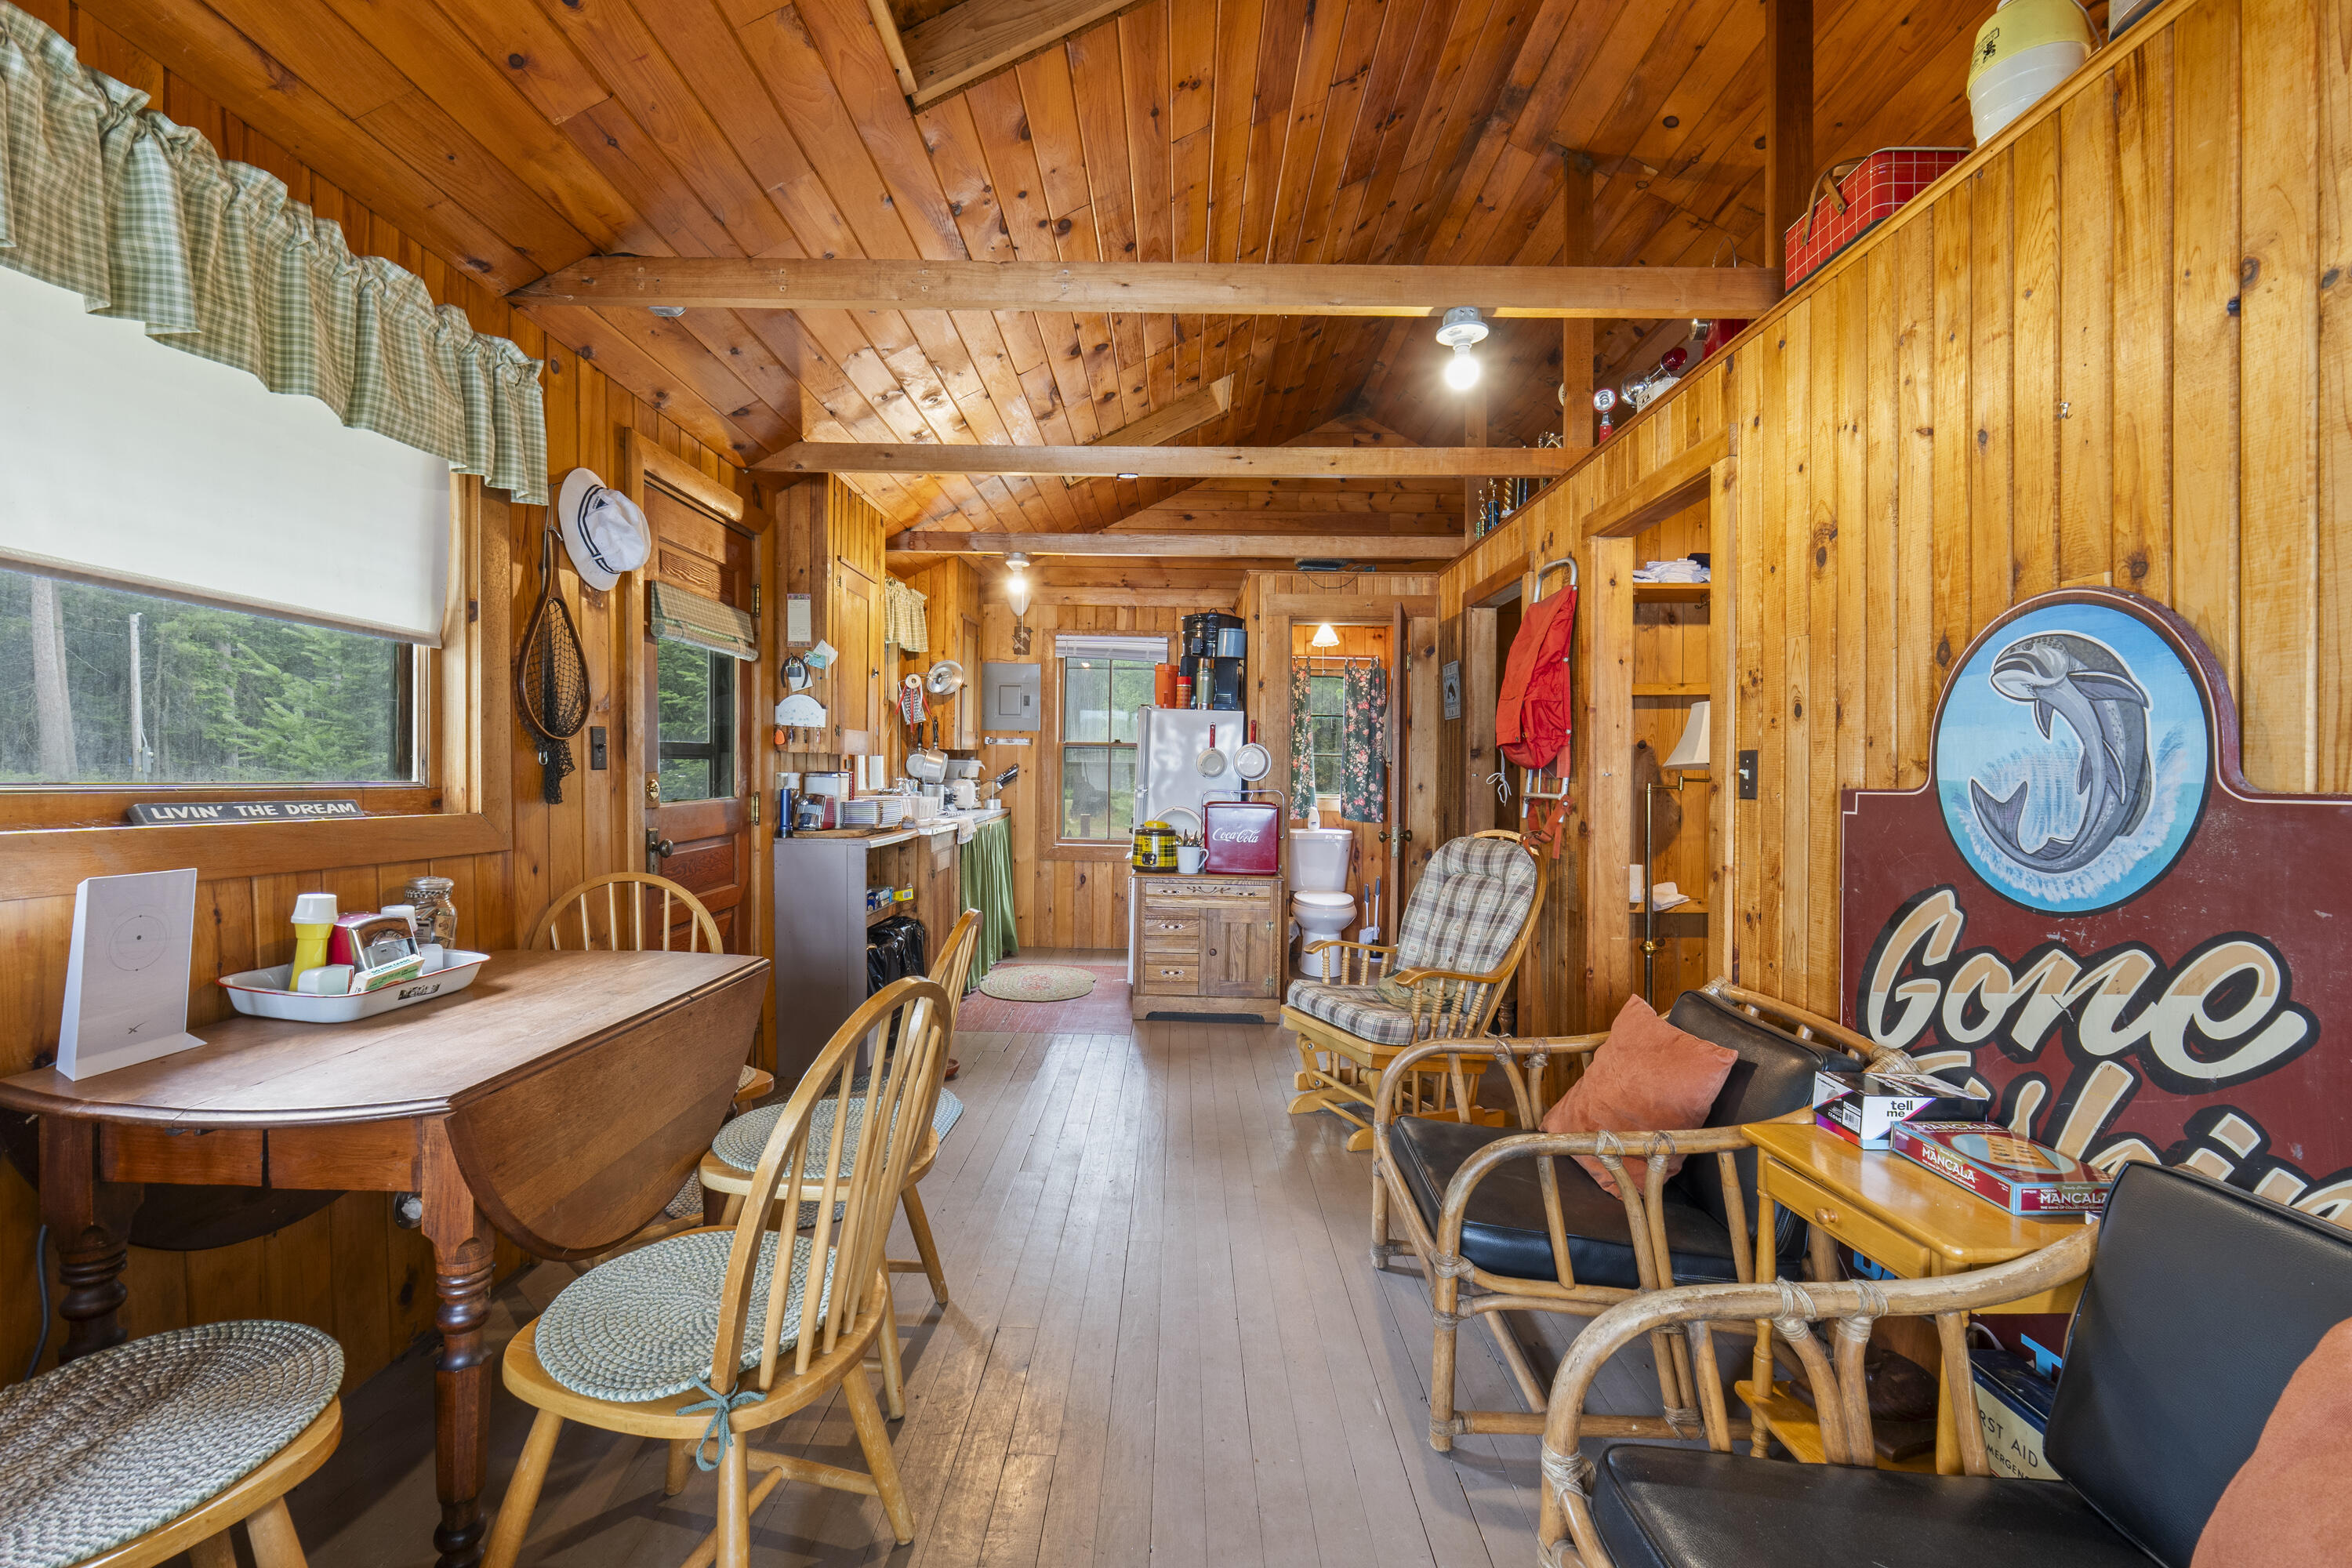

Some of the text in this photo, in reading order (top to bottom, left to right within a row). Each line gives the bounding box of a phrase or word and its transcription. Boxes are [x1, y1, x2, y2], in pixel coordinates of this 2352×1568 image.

[150, 803, 356, 819] LIVIN' THE DREAM
[1867, 888, 2308, 1080] Gone
[1890, 1100, 1913, 1111] tell
[1922, 1146, 1976, 1183] MANCALA
[1979, 1409, 2038, 1468] RST AID
[1986, 1443, 2030, 1480] MERGEN
